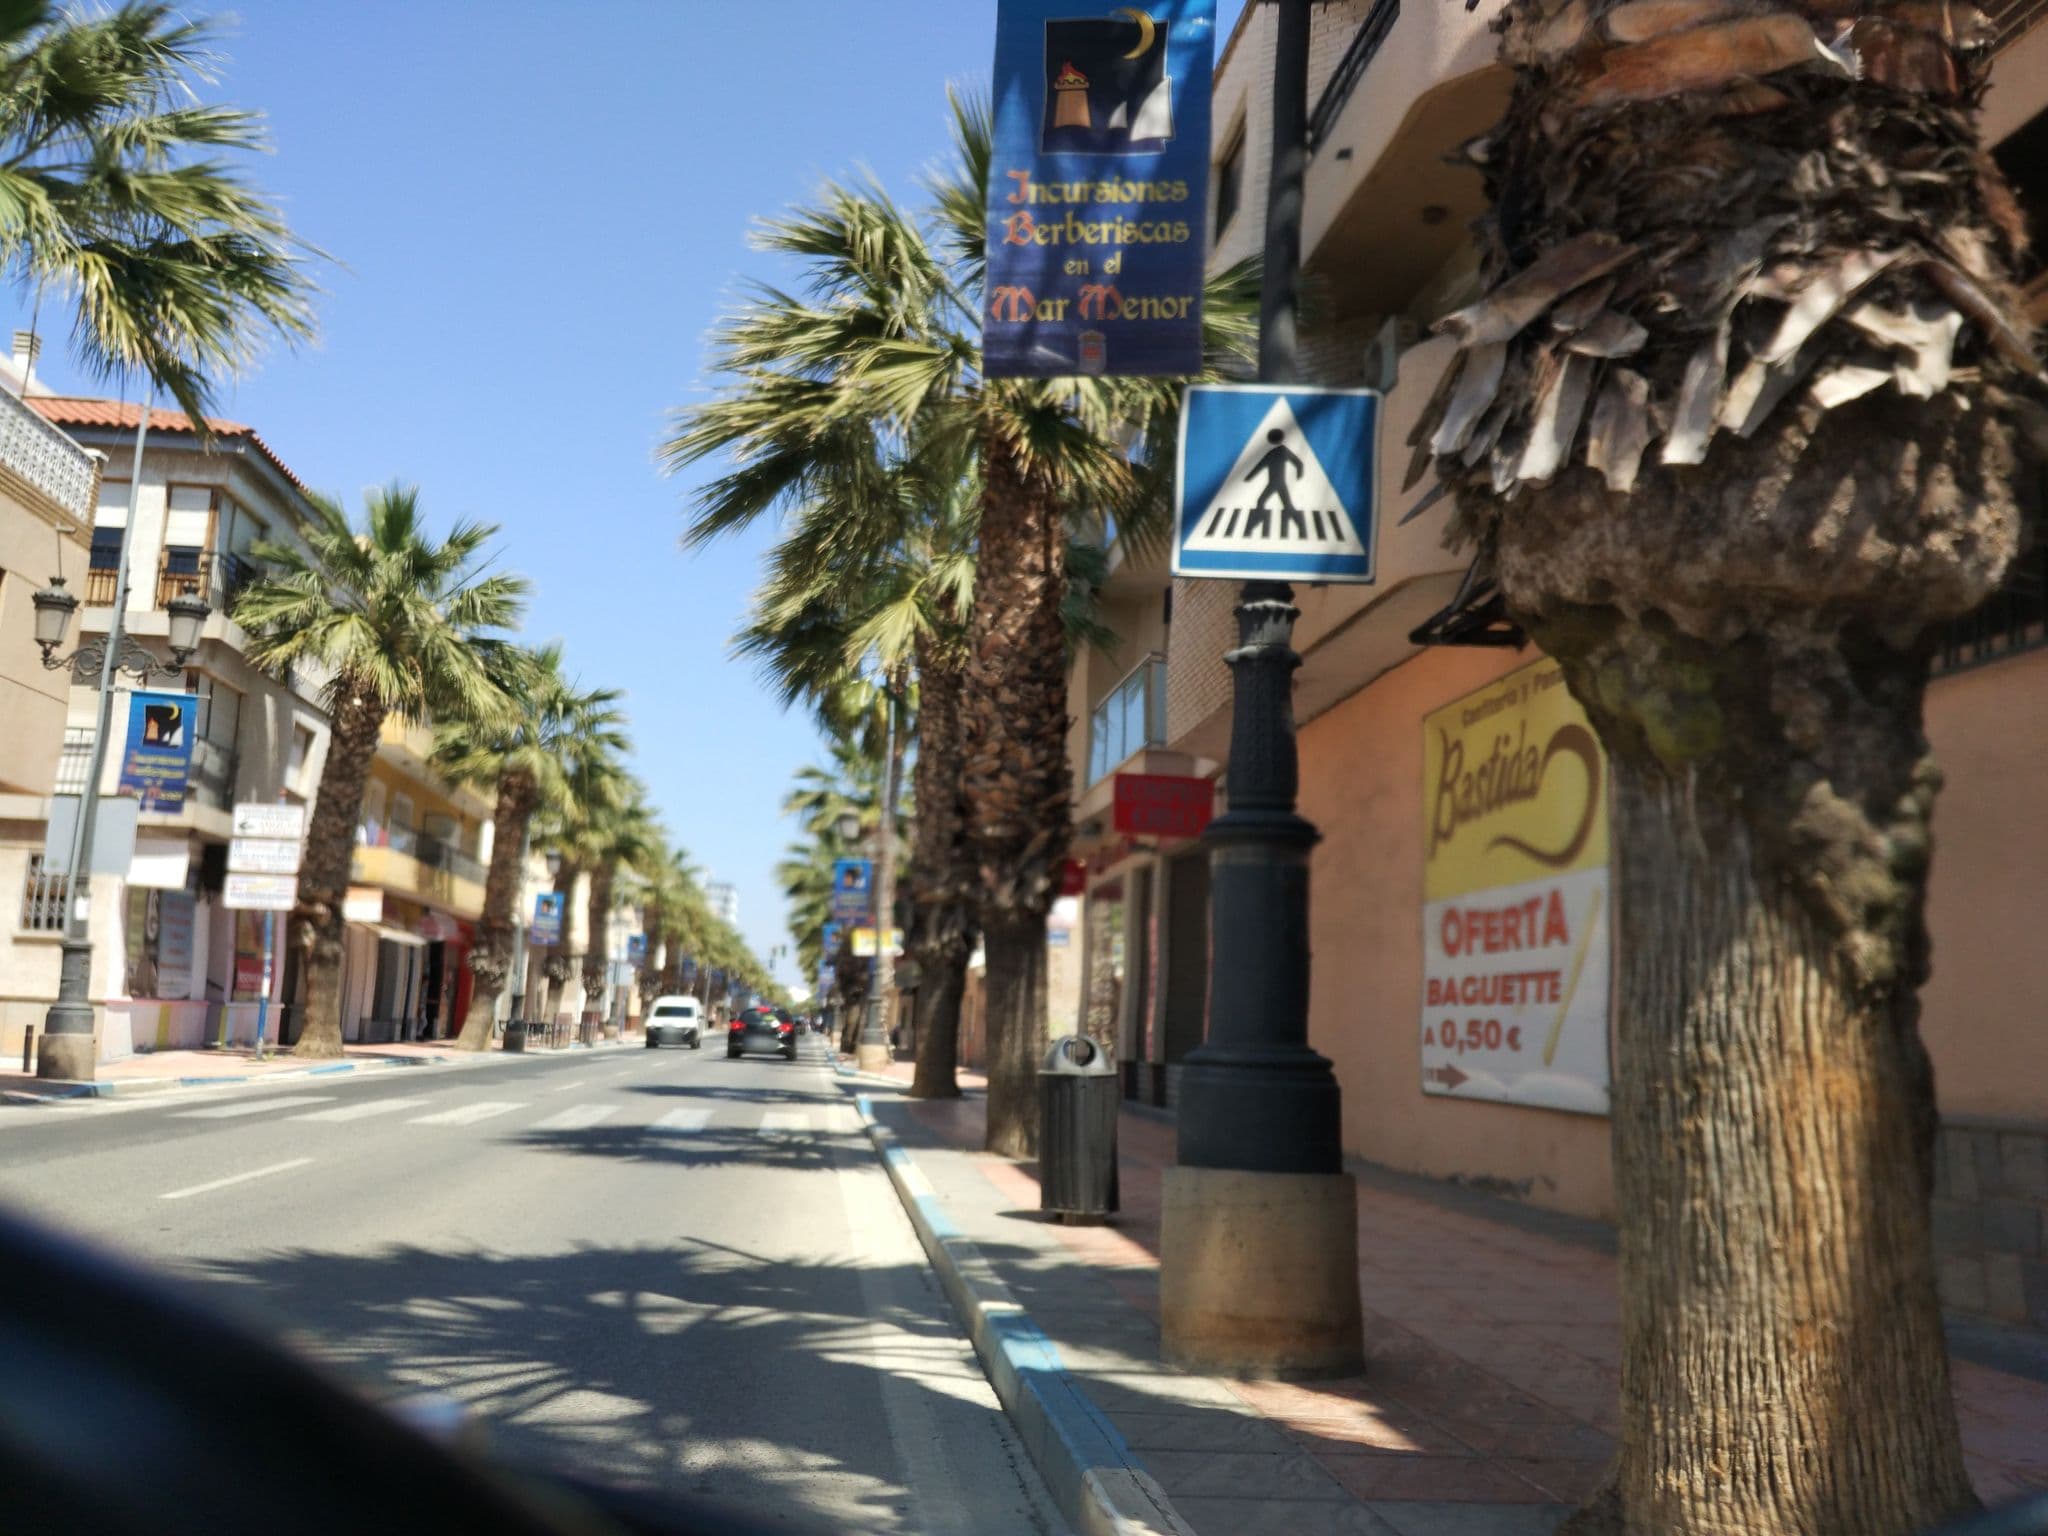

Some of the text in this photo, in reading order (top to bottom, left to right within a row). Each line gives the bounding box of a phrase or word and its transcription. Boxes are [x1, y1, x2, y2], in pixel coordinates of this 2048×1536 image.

[1006, 169, 1189, 204] Incursiones
[1001, 210, 1190, 246] Berberiscas
[1063, 250, 1123, 276] en el
[991, 283, 1195, 323] Mar Menor
[1429, 719, 1541, 861] Bastida
[1440, 887, 1569, 957] OFERTA
[1426, 969, 1563, 1007] BAGUETTE
[1423, 1026, 1436, 1046] A
